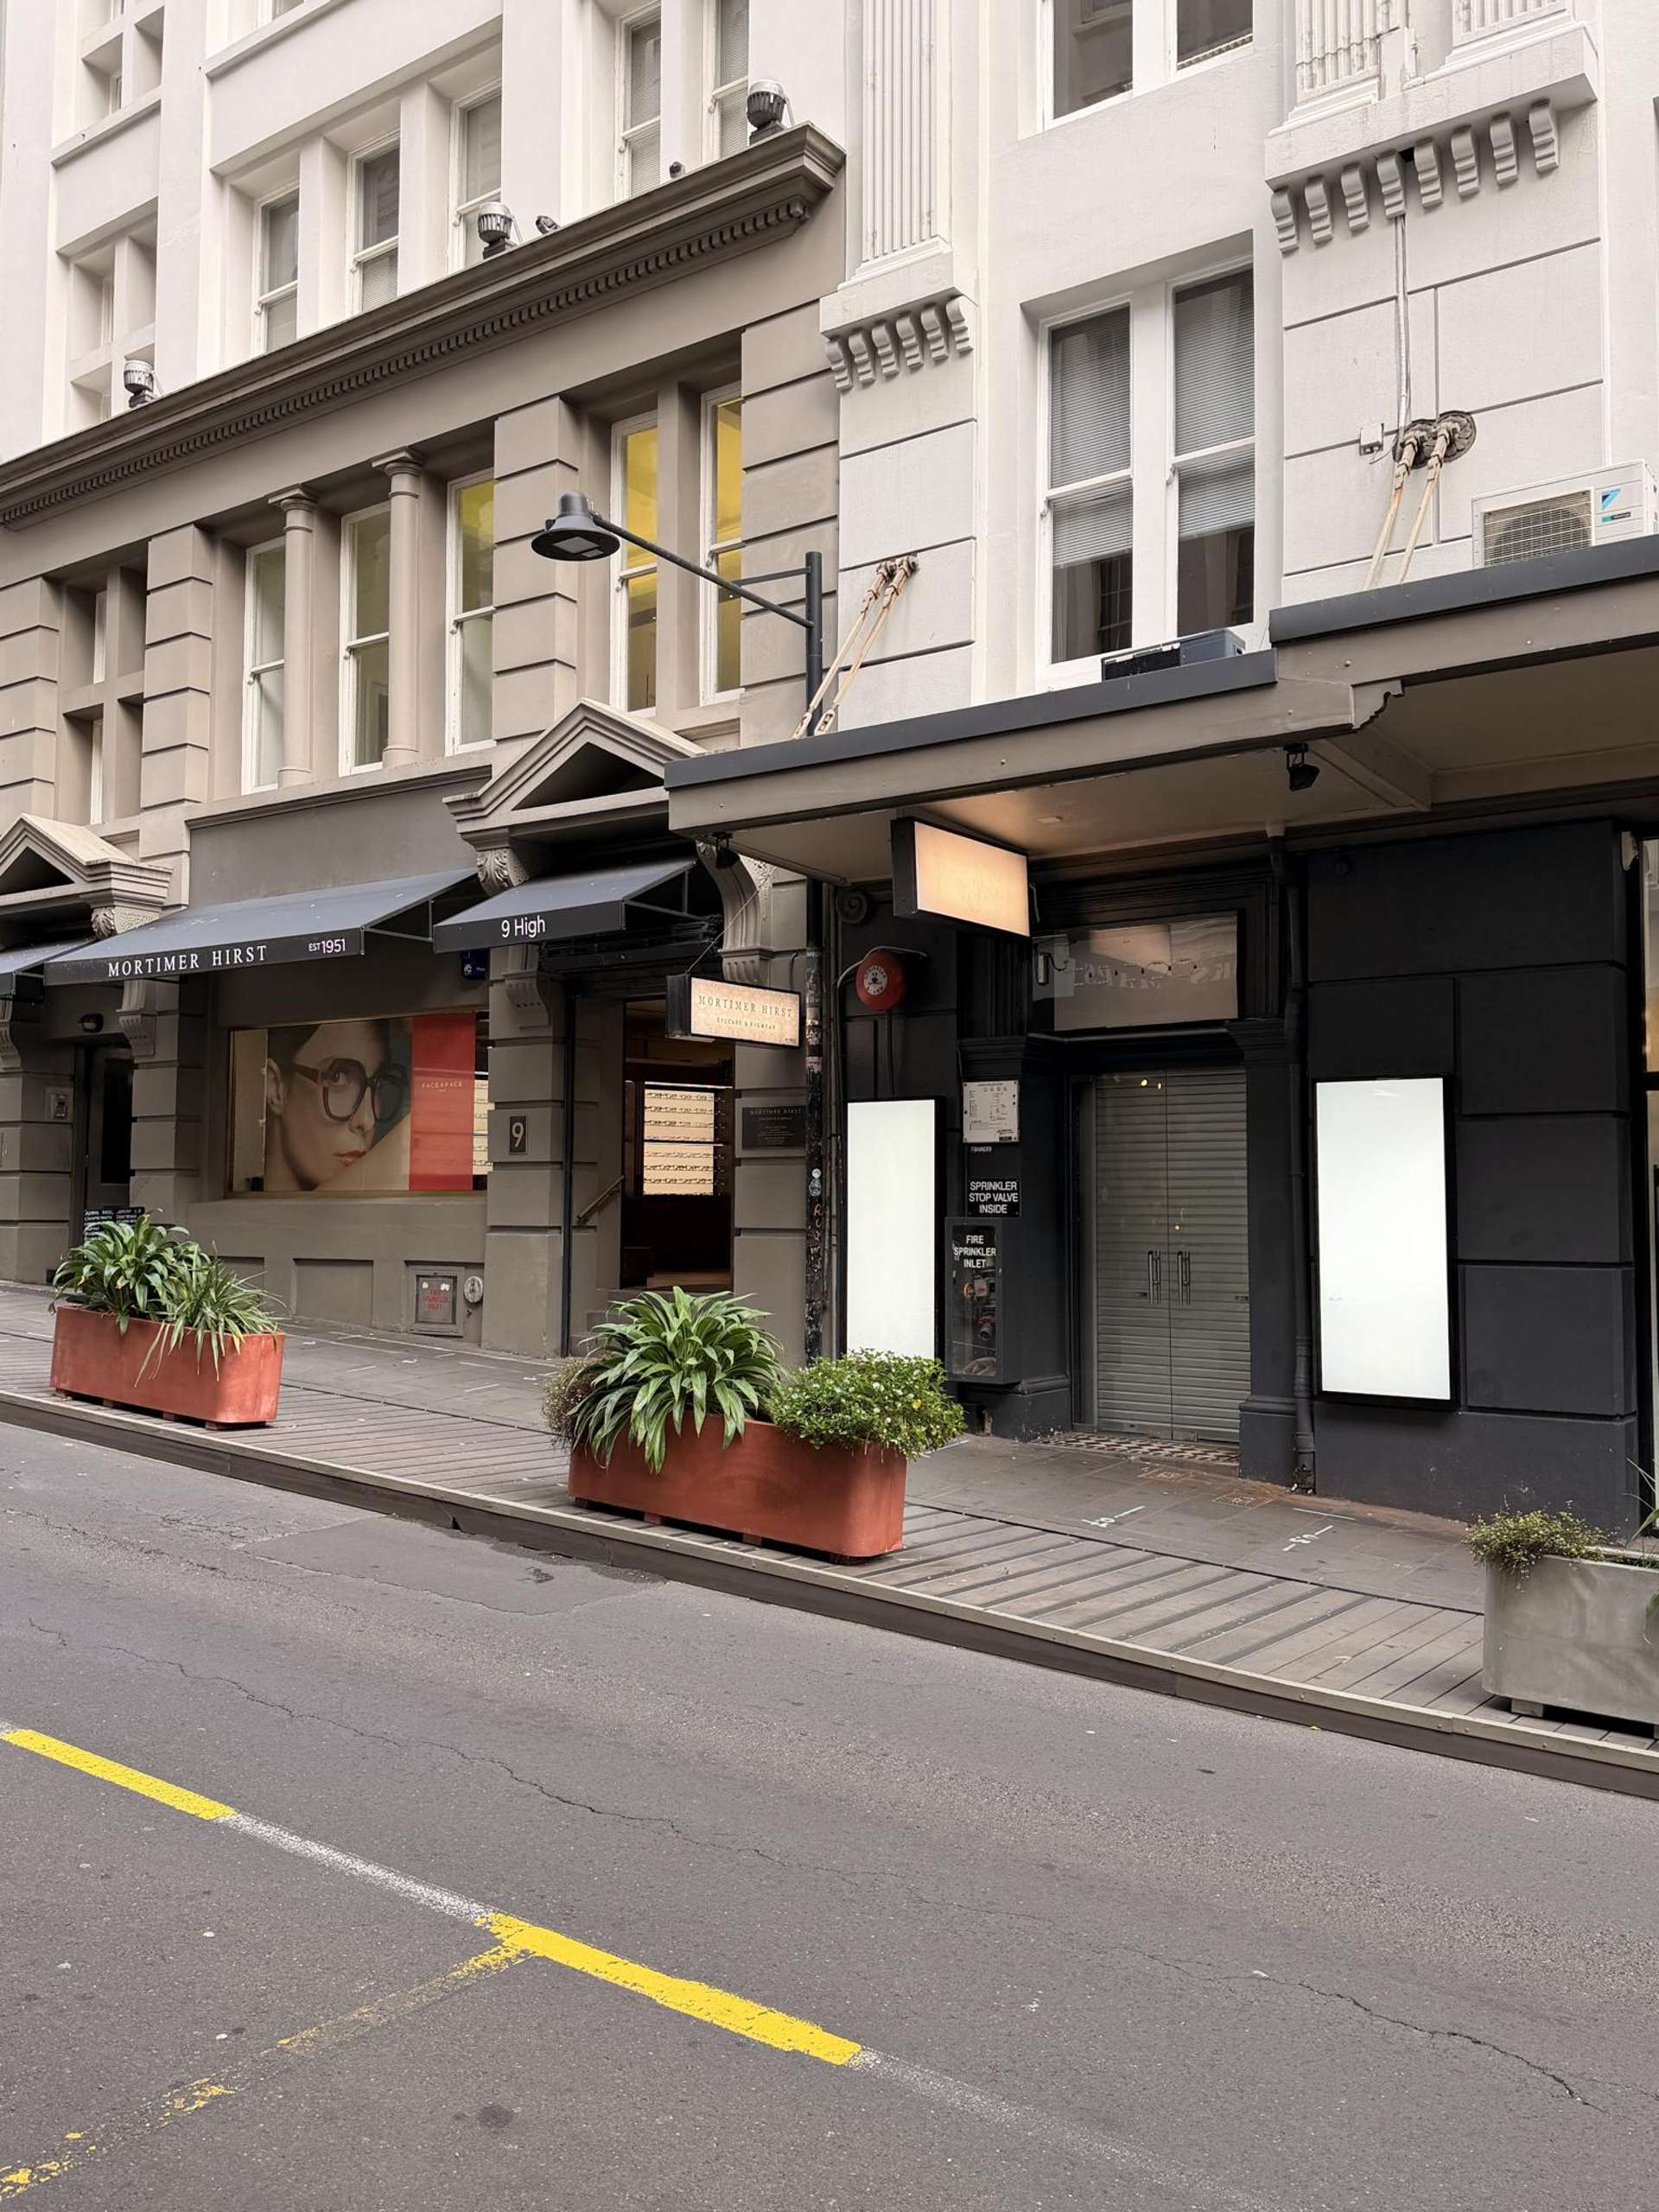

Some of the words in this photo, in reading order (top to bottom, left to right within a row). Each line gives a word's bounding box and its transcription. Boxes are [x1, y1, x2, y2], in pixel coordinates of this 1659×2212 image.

[501, 919, 511, 938] 9
[514, 914, 546, 938] High
[308, 942, 321, 952] EST
[321, 938, 346, 954] 1951
[108, 954, 200, 977] MORTIMER
[212, 944, 268, 966] HIRST
[698, 995, 756, 1013] MORTIMER
[761, 1005, 792, 1017] HIRST
[512, 1122, 524, 1147] 9
[969, 1181, 1017, 1191] SPRINKLER
[969, 1192, 991, 1203] STOP
[993, 1192, 1019, 1202] VALVE
[979, 1204, 1008, 1214] INSIDE
[966, 1235, 984, 1244] FIRE
[953, 1247, 996, 1256] SPRINKLER
[963, 1258, 987, 1268] INLET
